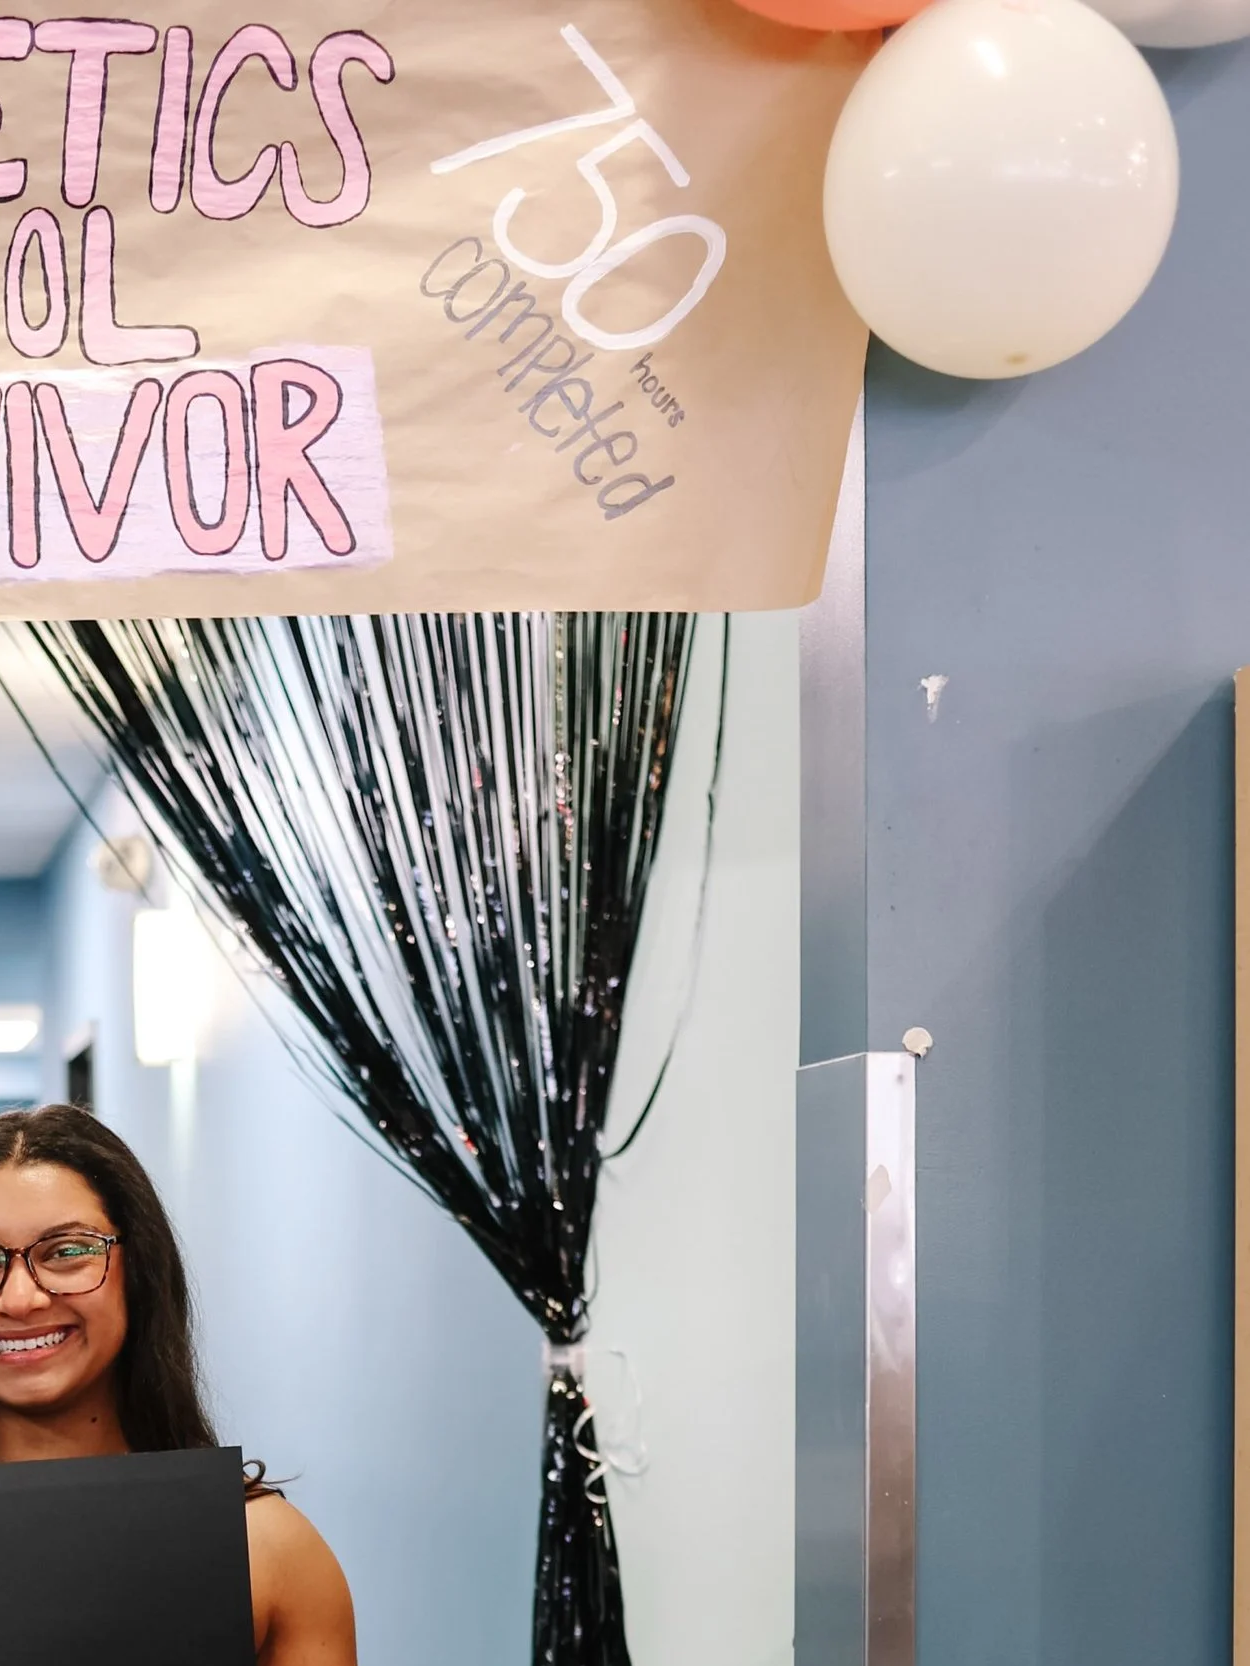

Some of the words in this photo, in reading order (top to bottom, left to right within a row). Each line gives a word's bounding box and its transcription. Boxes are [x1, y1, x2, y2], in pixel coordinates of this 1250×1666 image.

[430, 23, 727, 351] 750
[420, 236, 675, 521] completed
[630, 352, 686, 428] hours
